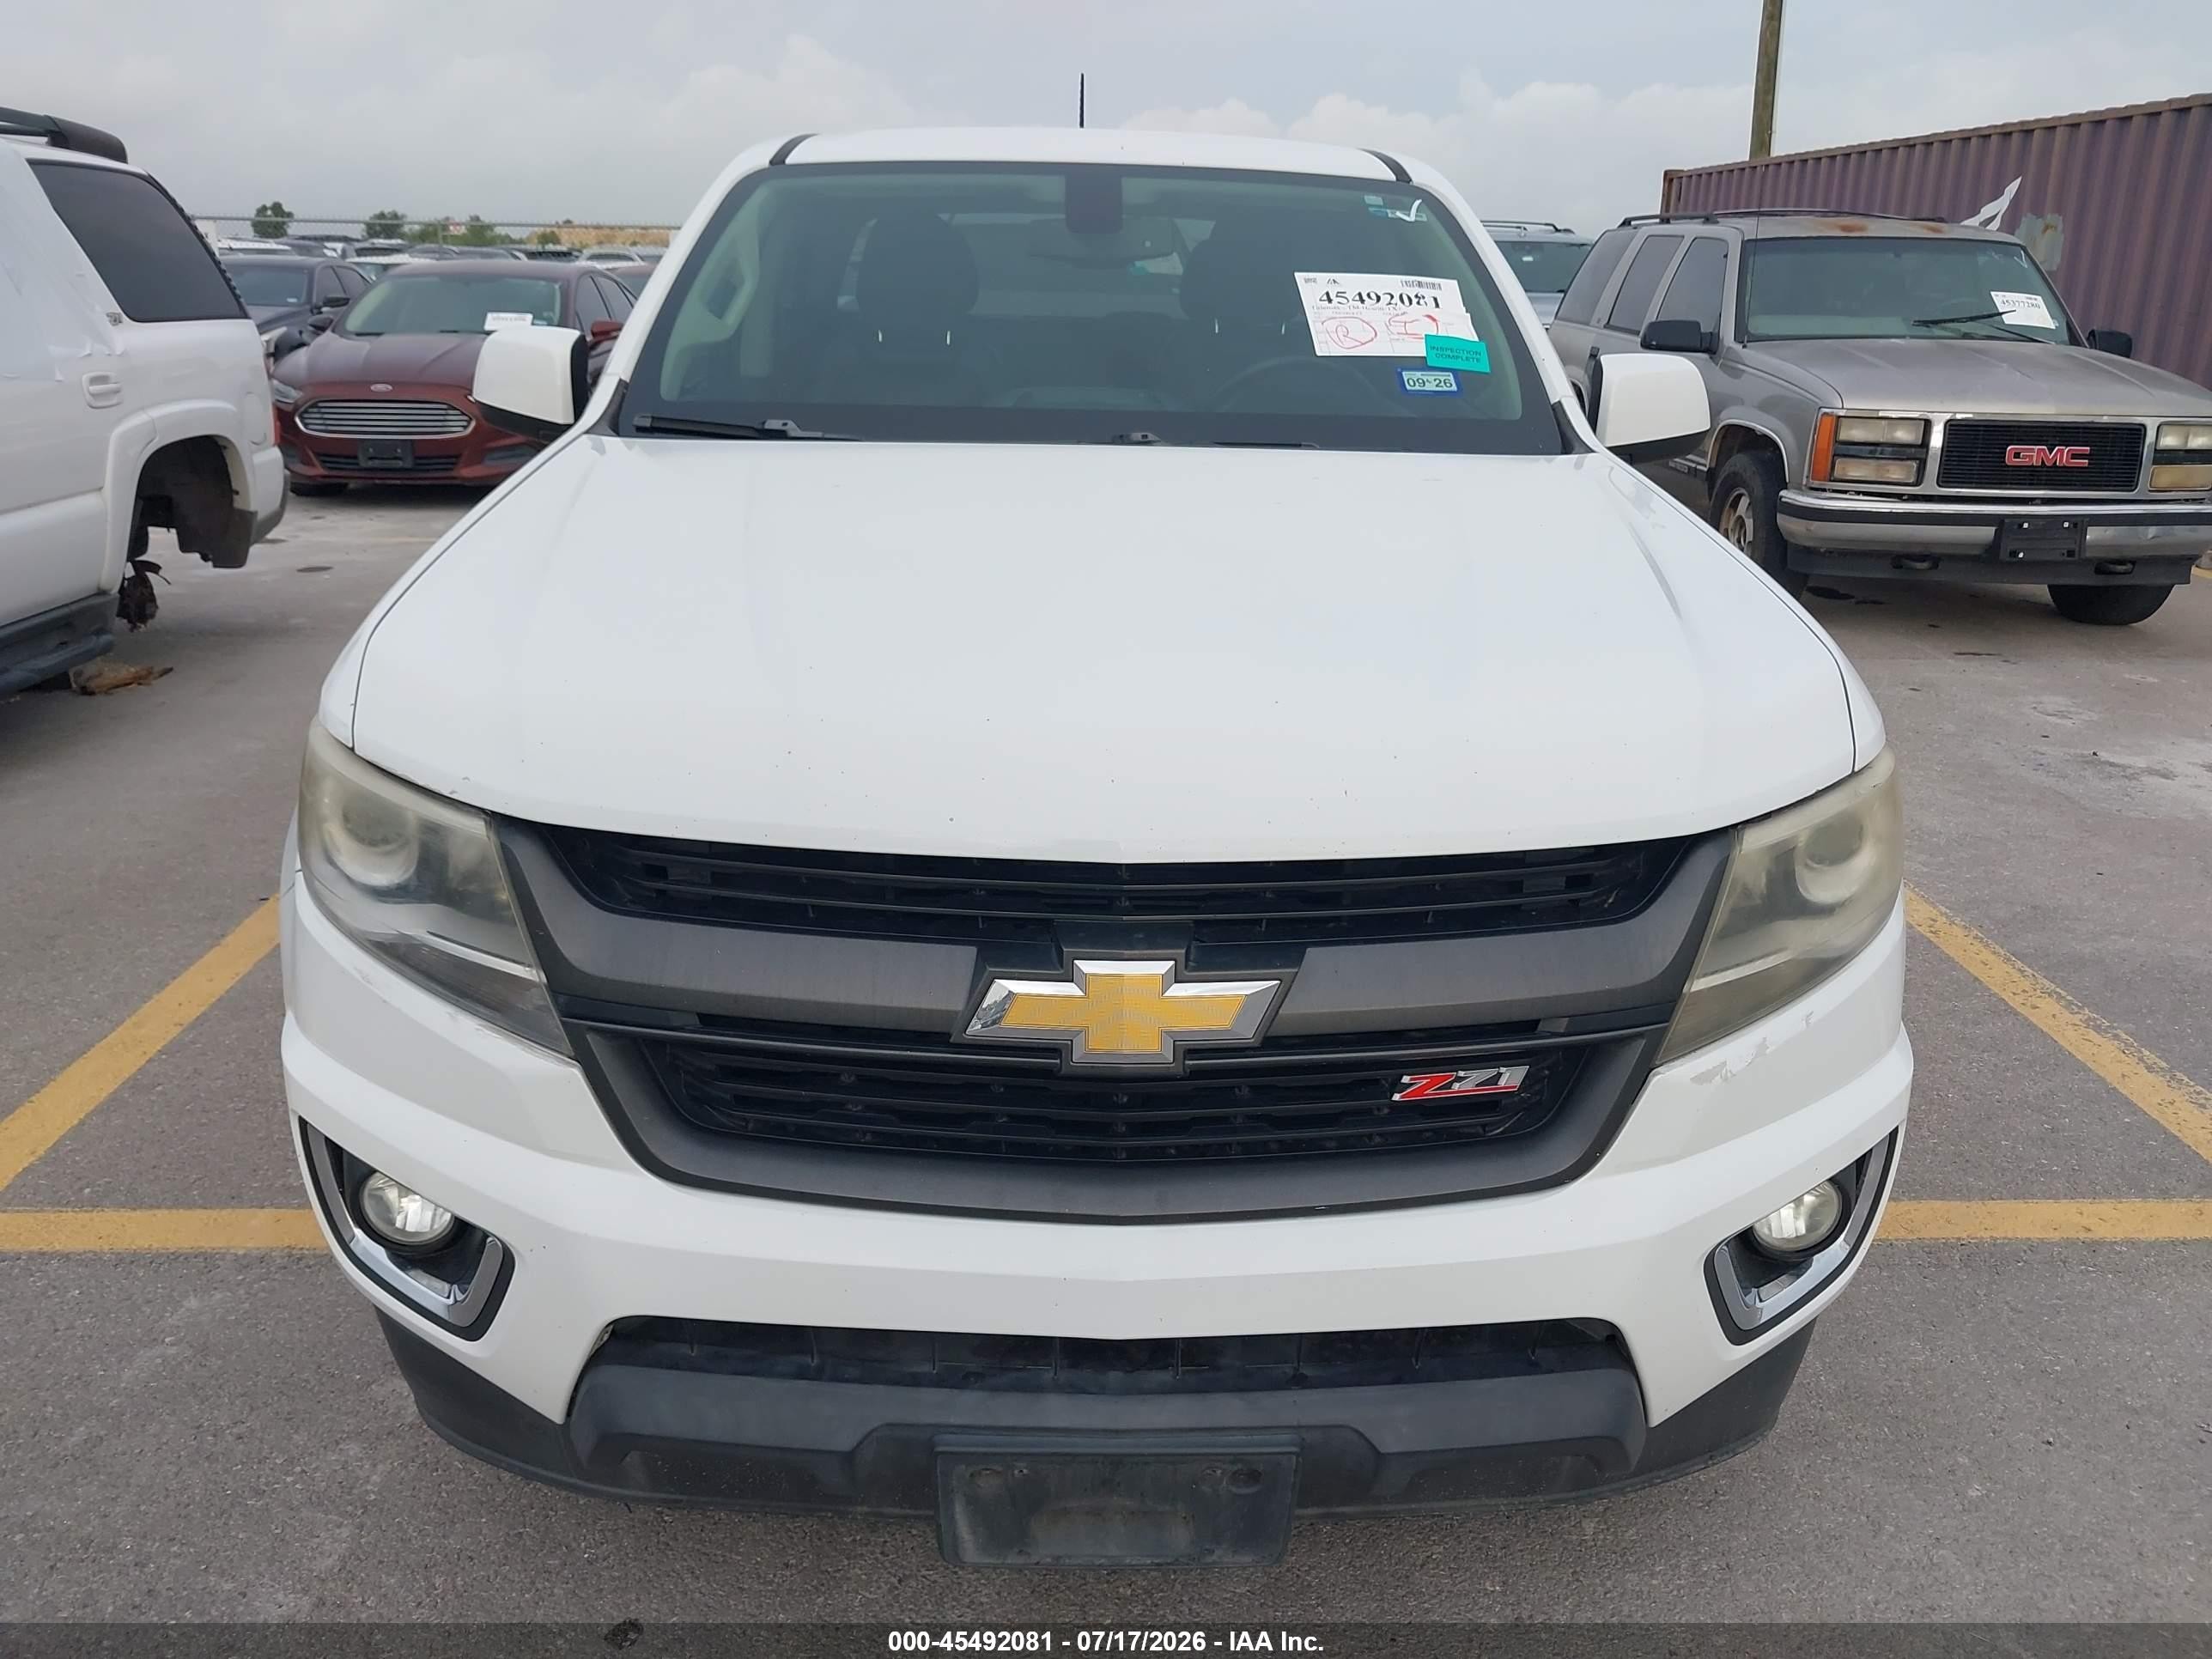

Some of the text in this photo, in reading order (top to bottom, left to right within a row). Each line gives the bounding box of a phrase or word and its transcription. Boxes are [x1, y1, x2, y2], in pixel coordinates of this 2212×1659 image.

[1318, 290, 1443, 309] 45492081
[1430, 345, 1482, 357] INSPECTION
[1435, 353, 1481, 363] COMPLETE
[2005, 445, 2090, 467] GMC
[1391, 1066, 1530, 1101] Z71
